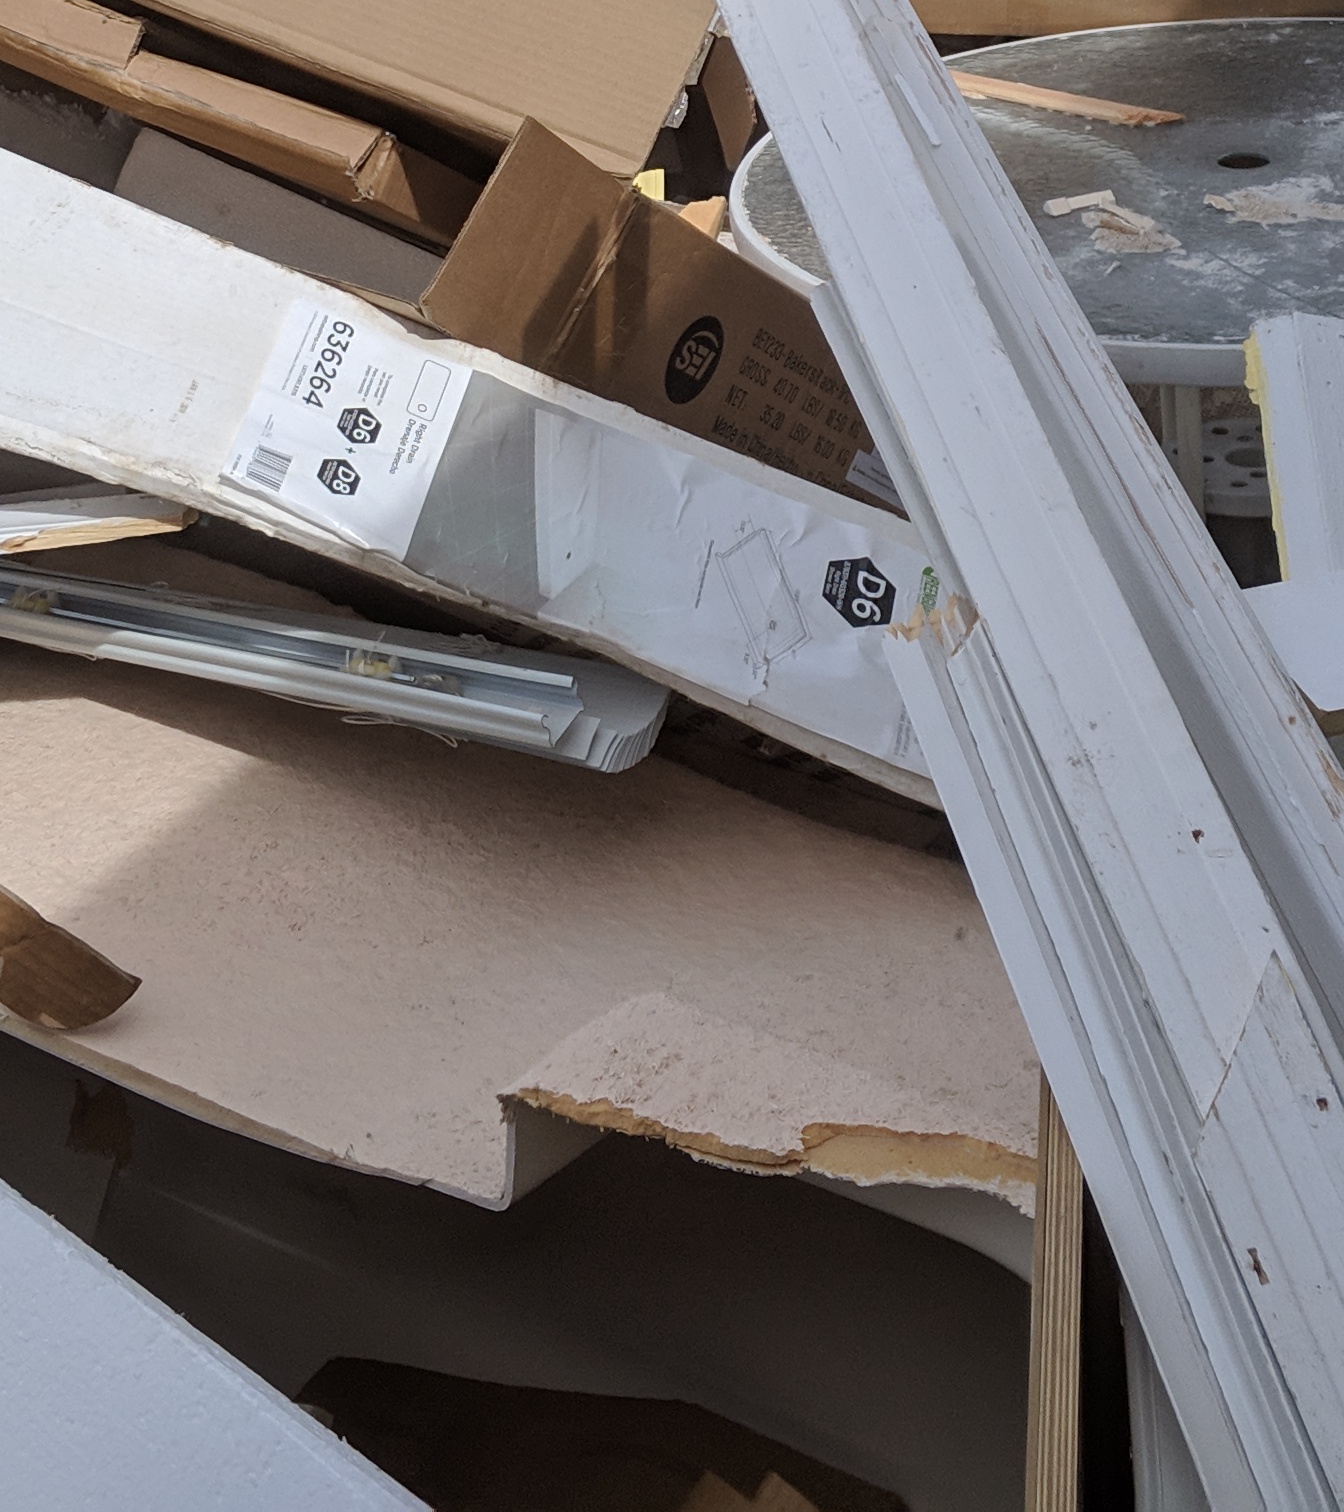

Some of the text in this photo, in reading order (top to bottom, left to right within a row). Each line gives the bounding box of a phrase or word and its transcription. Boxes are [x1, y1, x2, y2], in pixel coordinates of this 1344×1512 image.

[301, 320, 355, 409] 636264
[736, 354, 775, 387] GROSS
[348, 410, 379, 446] D6
[405, 422, 428, 464] Right Drain
[708, 413, 742, 444] Made
[734, 428, 754, 450] in
[328, 463, 358, 497] D8
[848, 569, 888, 622] D6
